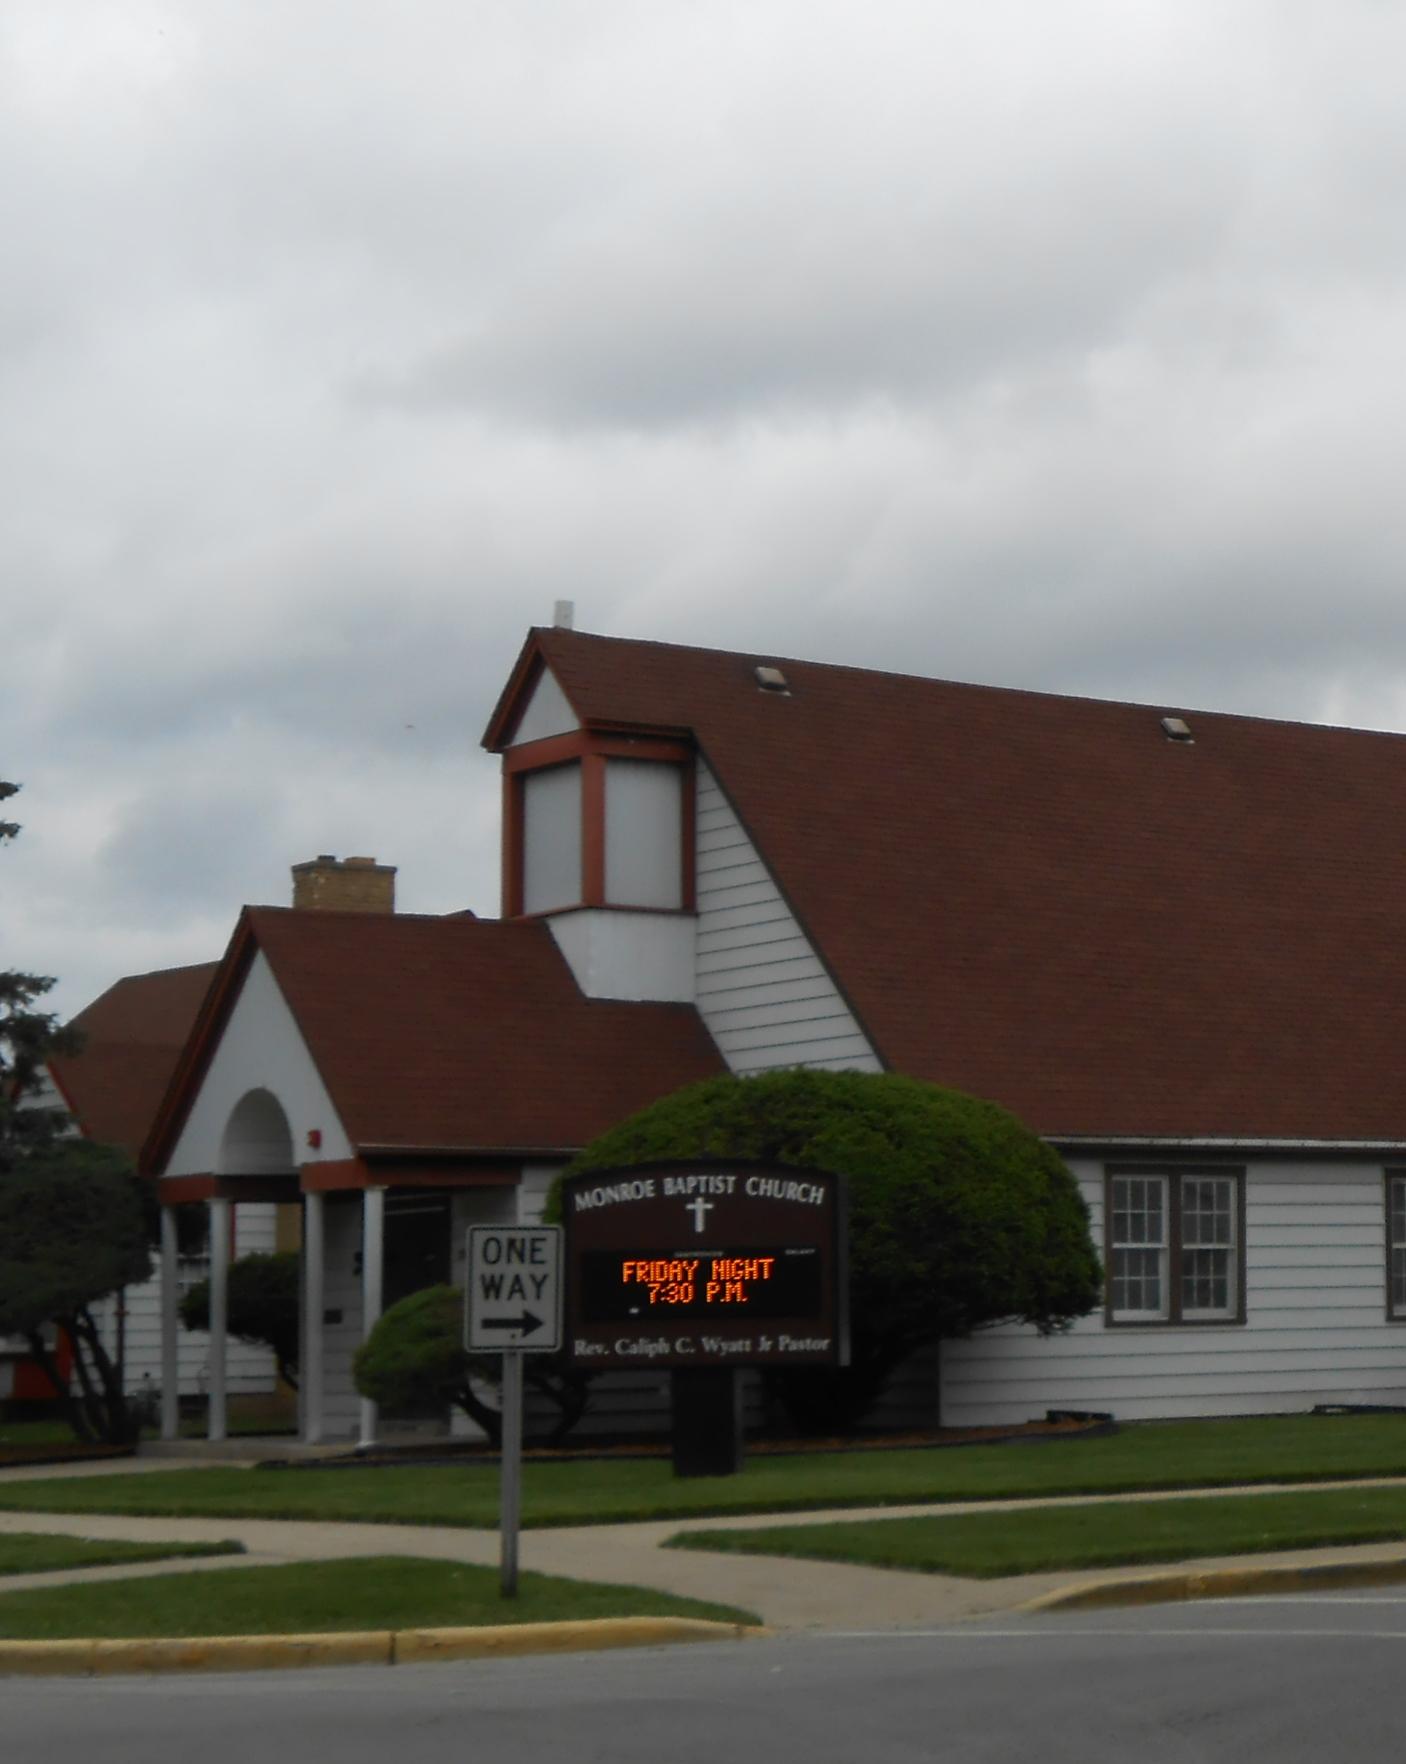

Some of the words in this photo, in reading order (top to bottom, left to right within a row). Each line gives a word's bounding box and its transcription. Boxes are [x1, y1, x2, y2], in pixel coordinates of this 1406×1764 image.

[575, 1180, 655, 1211] MONROE
[663, 1176, 737, 1196] BAPTIST
[745, 1177, 824, 1205] CHURCH
[483, 1237, 548, 1265] ONE
[622, 1260, 699, 1282] FRIDAY
[712, 1258, 775, 1280] NIGHT
[481, 1274, 549, 1301] WAY
[648, 1283, 694, 1303] 7:30
[706, 1281, 748, 1302] P.M.
[574, 1339, 610, 1356] Rev.
[675, 1337, 696, 1354] C.
[701, 1336, 752, 1356] Wyatt
[778, 1334, 831, 1351] Pastor
